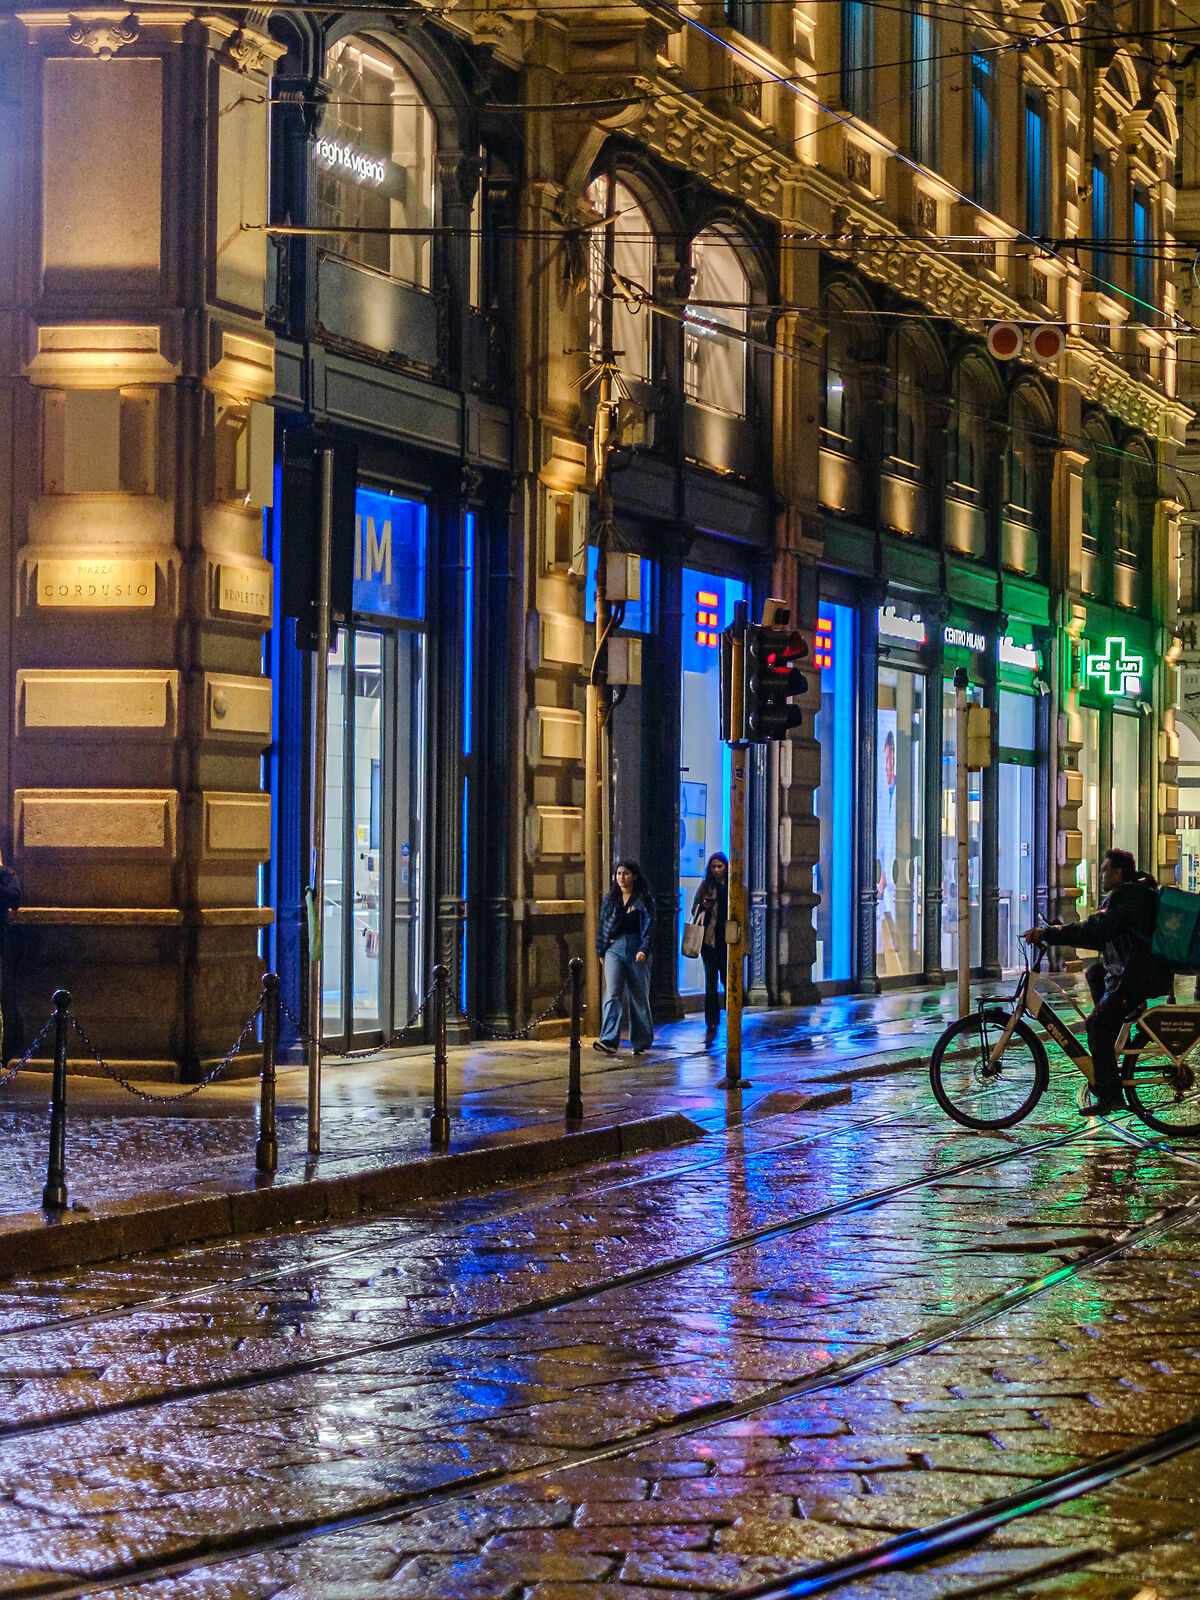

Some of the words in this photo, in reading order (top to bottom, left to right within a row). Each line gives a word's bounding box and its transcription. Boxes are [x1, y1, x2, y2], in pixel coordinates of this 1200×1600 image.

[77, 565, 113, 575] PIAZZA
[44, 584, 148, 597] CORDUSIO
[224, 588, 265, 606] BROLETTO
[945, 627, 966, 647] CENTRO
[966, 632, 985, 652] MILANO
